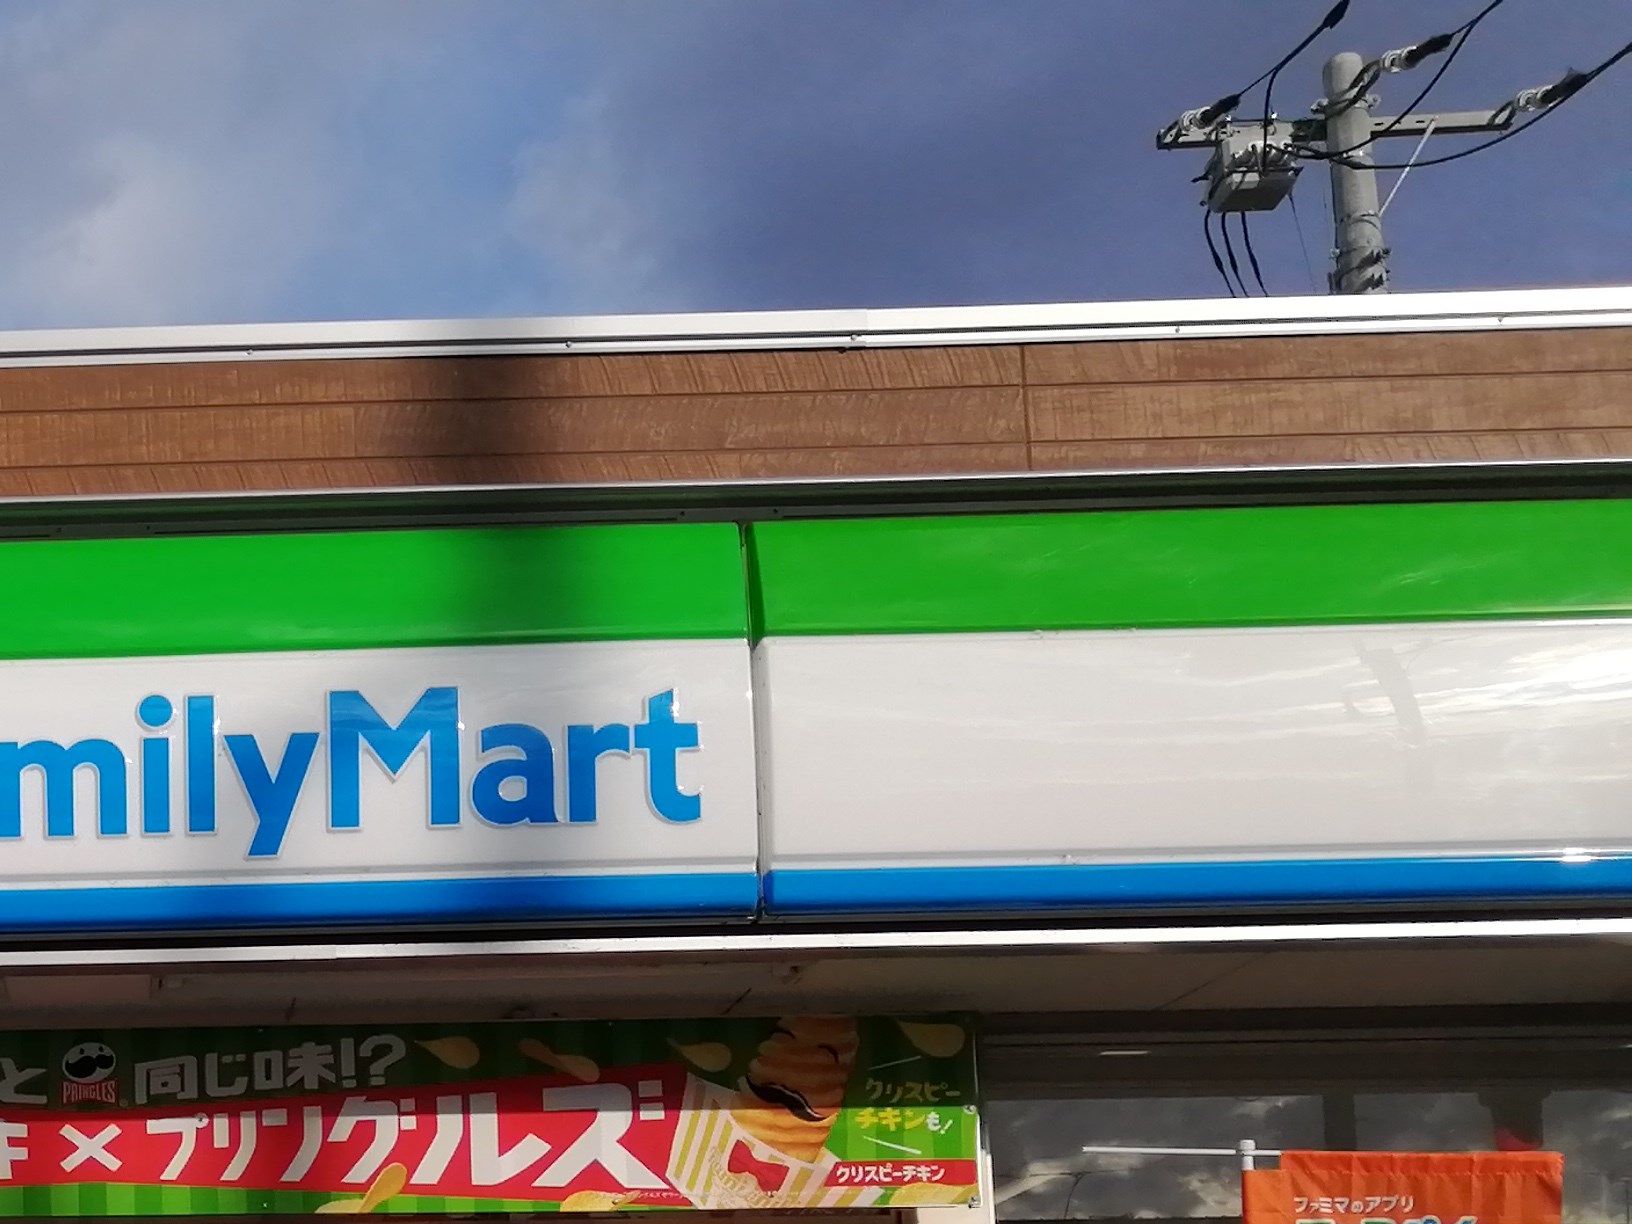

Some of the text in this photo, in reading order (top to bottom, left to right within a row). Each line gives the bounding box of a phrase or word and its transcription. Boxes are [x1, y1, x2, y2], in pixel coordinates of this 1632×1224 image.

[63, 1081, 116, 1105] PRINGLES
[866, 1079, 960, 1102] クリスピー
[836, 1164, 945, 1182] クリスピーチキン
[1294, 1195, 1414, 1214] ファミマのアプリ
